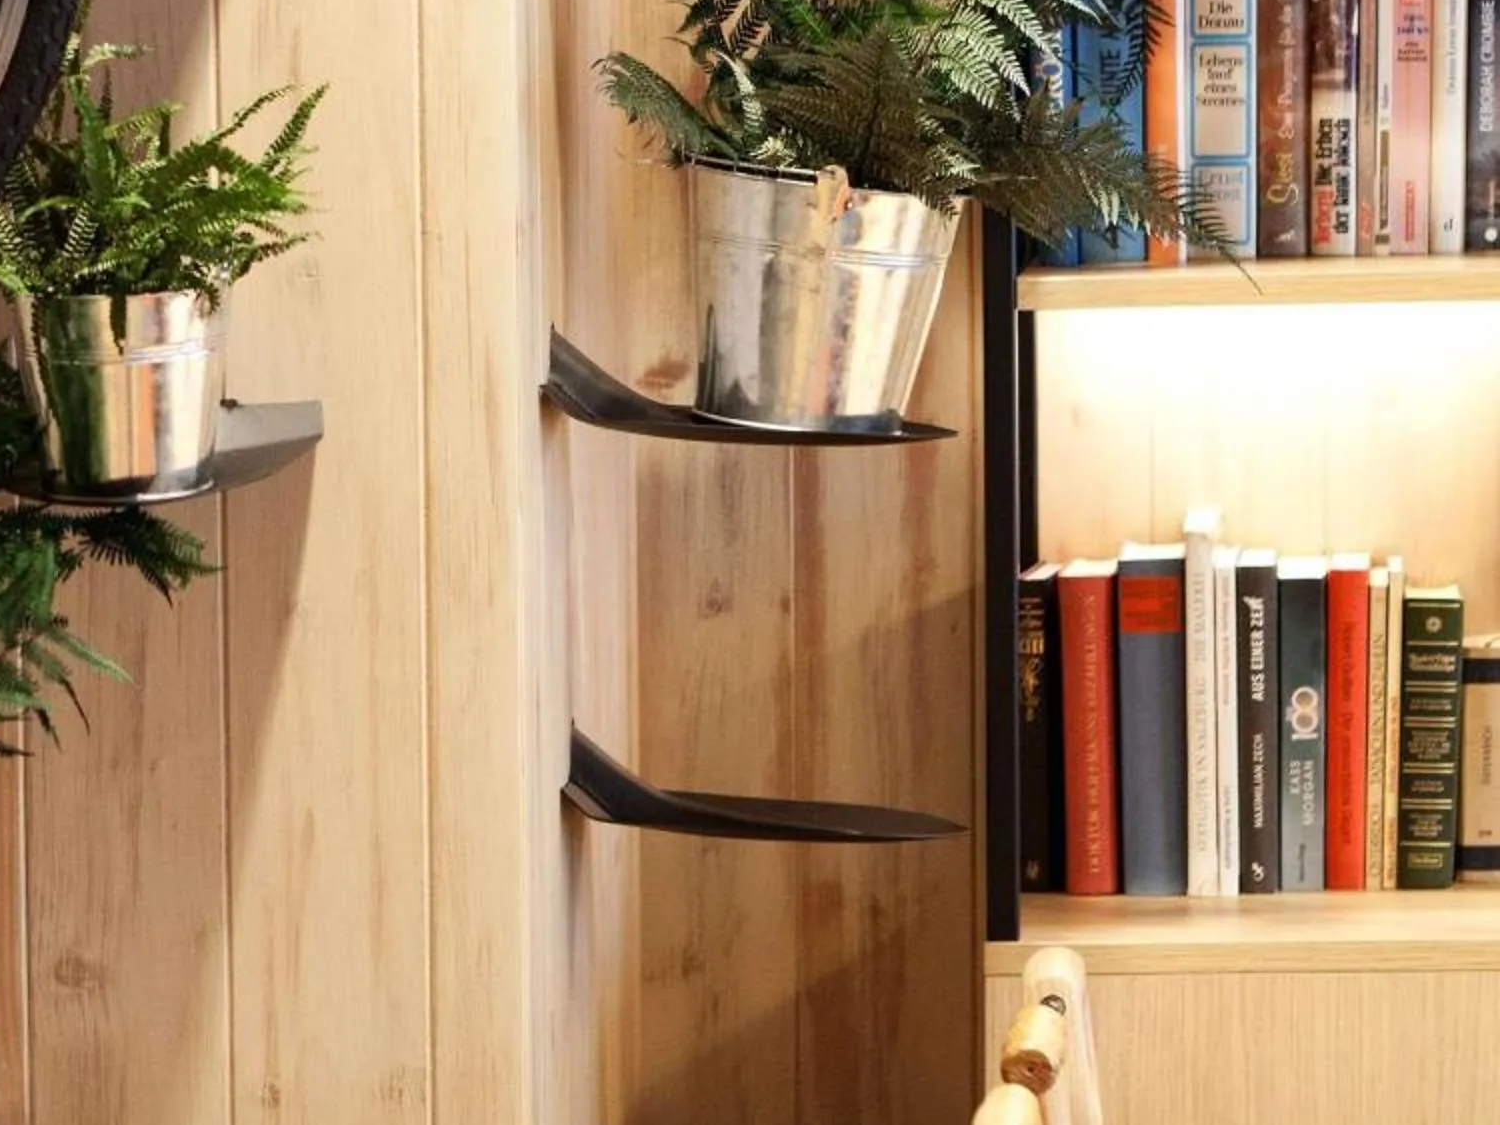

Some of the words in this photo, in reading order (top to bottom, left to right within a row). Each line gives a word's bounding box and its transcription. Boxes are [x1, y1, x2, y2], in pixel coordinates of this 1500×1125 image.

[1198, 15, 1245, 29] Donau
[1209, 0, 1233, 15] Die
[1479, 0, 1495, 63] CROMBIE
[1480, 66, 1495, 132] DEBORAH
[1250, 630, 1264, 670] EINER
[1251, 673, 1265, 702] AUS
[1291, 686, 1320, 741] 100
[1253, 764, 1265, 829] MAXIMILIAN
[1290, 760, 1301, 794] KASS
[1304, 759, 1315, 826] MORGAN
